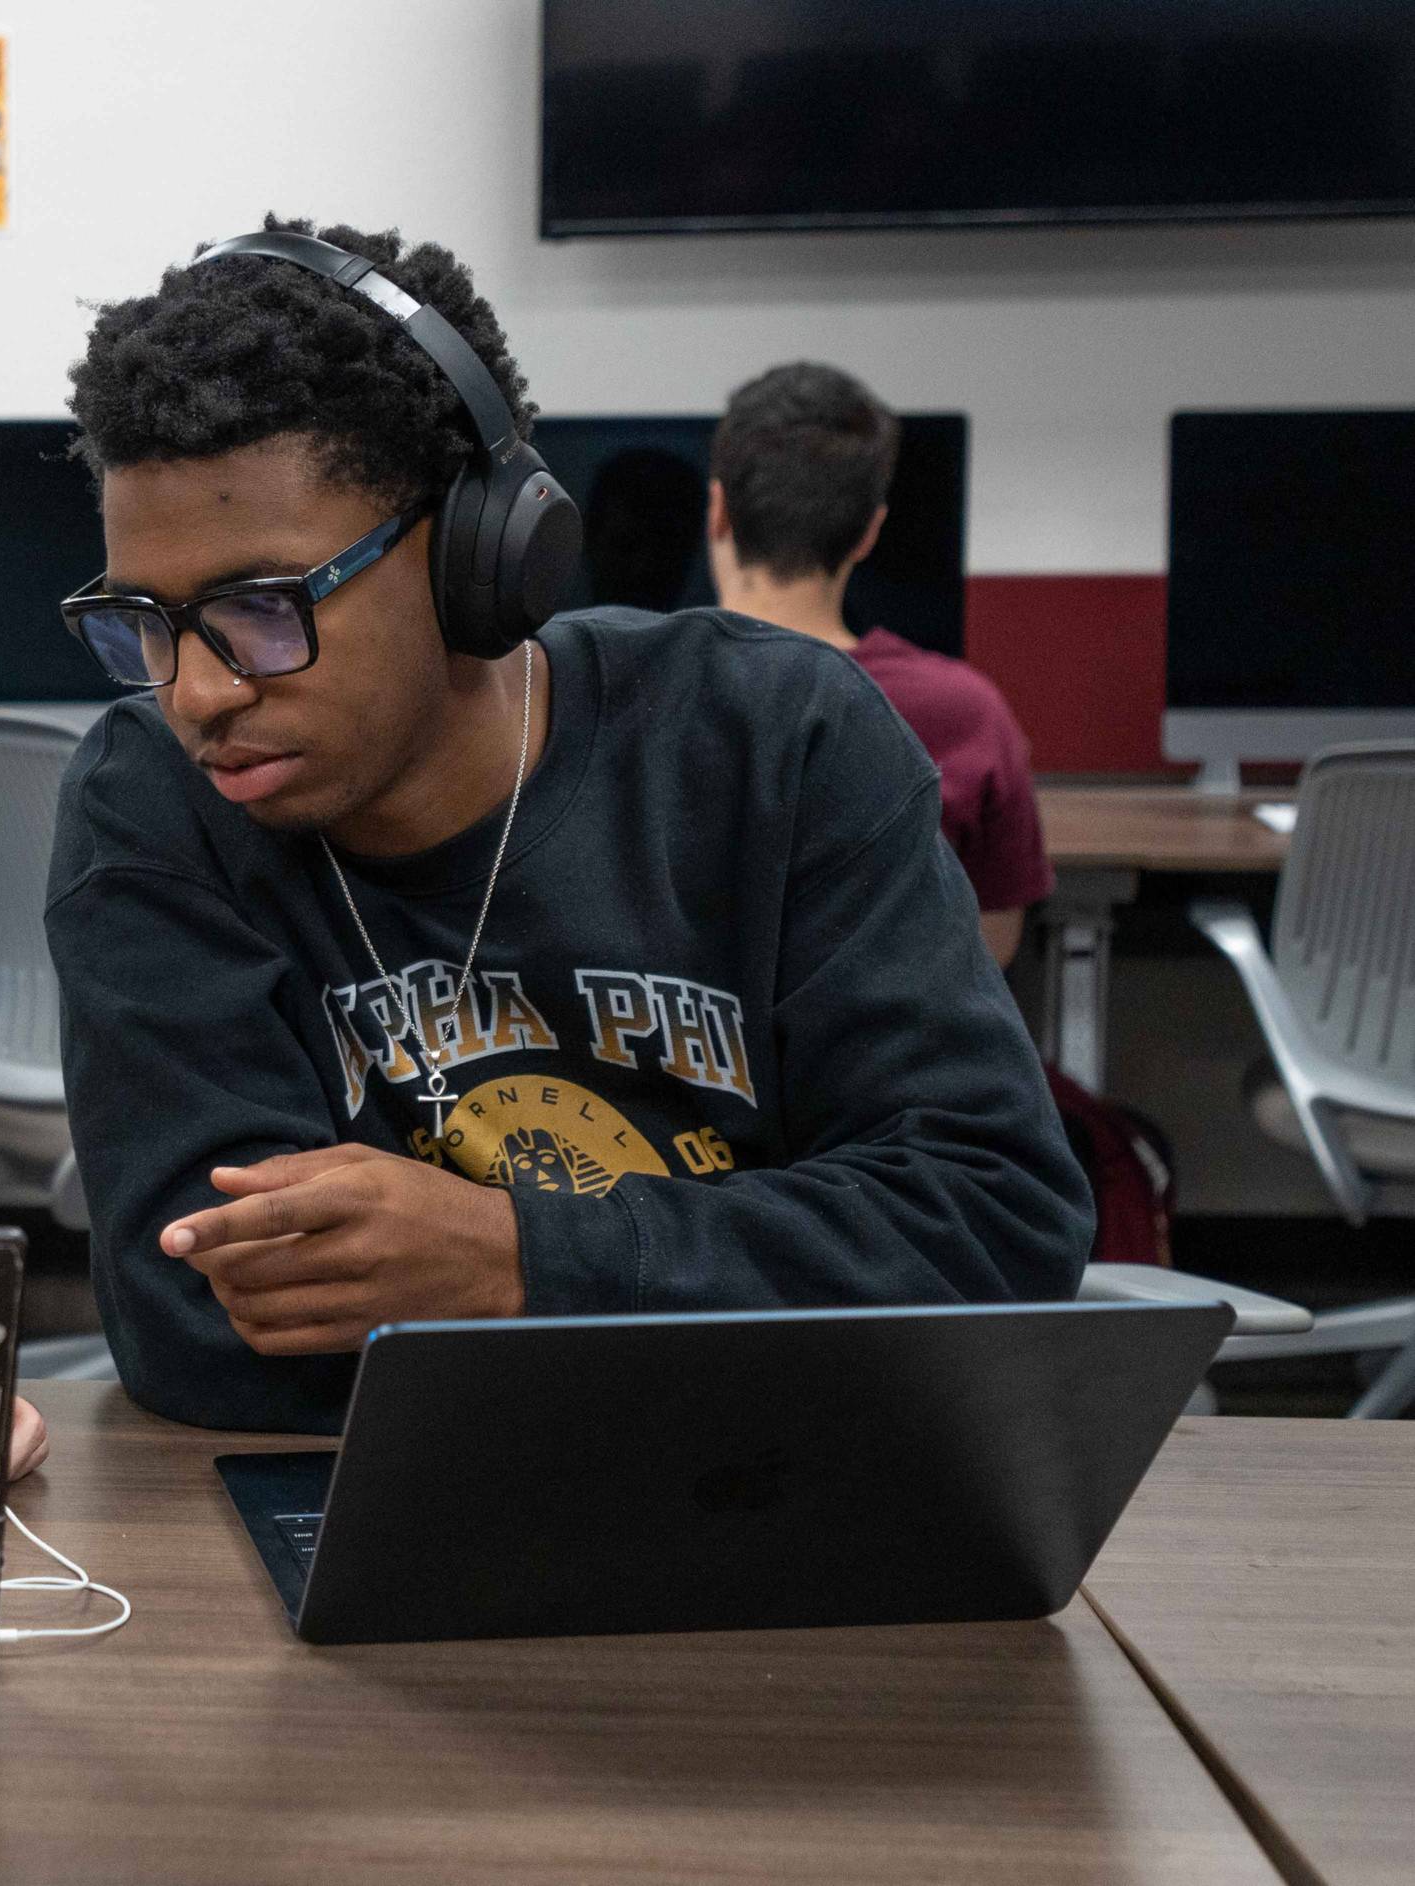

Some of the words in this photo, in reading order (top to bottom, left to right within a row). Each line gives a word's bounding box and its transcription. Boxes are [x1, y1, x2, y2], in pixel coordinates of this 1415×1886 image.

[574, 968, 758, 1108] PHI
[446, 1086, 630, 1150] ORNELL
[673, 1127, 735, 1174] 06
